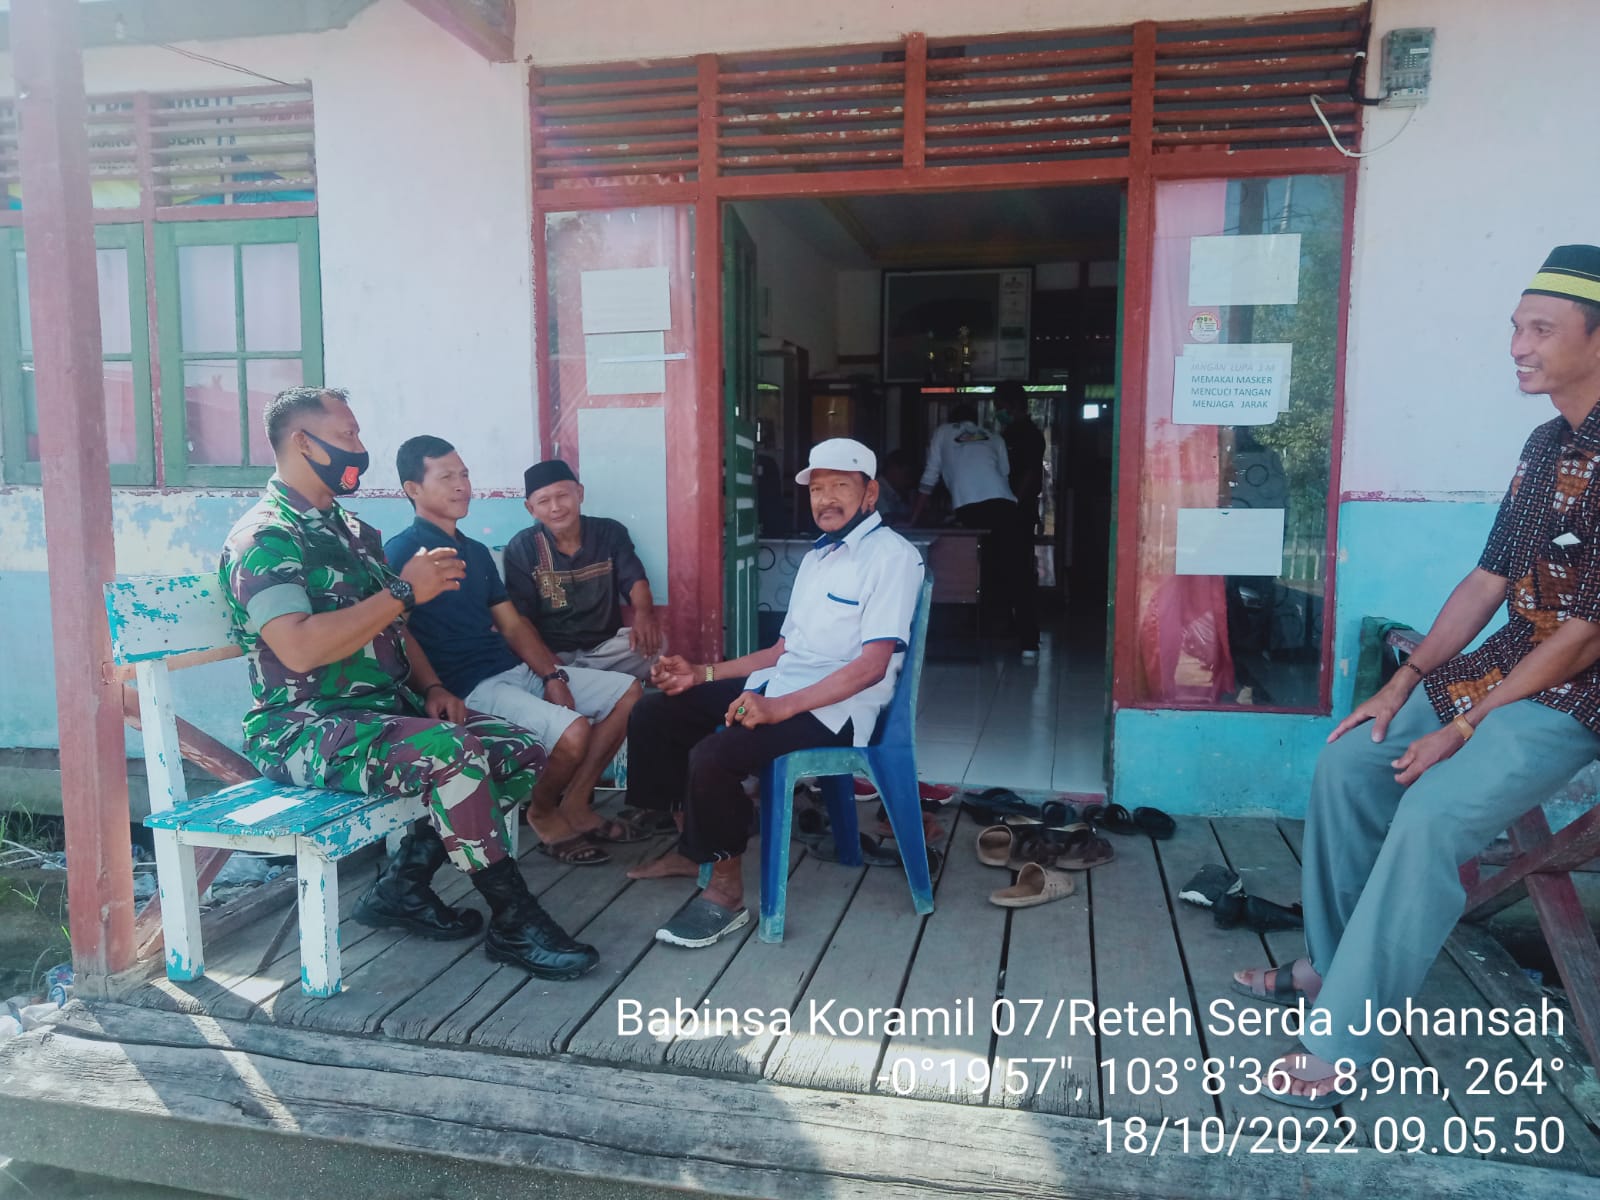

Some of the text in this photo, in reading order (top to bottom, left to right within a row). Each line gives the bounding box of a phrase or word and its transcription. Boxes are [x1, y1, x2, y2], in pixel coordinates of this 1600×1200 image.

[1191, 375, 1273, 385] MEMAKAI MASKER
[1190, 387, 1272, 397] MENCUCI TANGAN
[1192, 399, 1268, 409] MENJAGA JARAK
